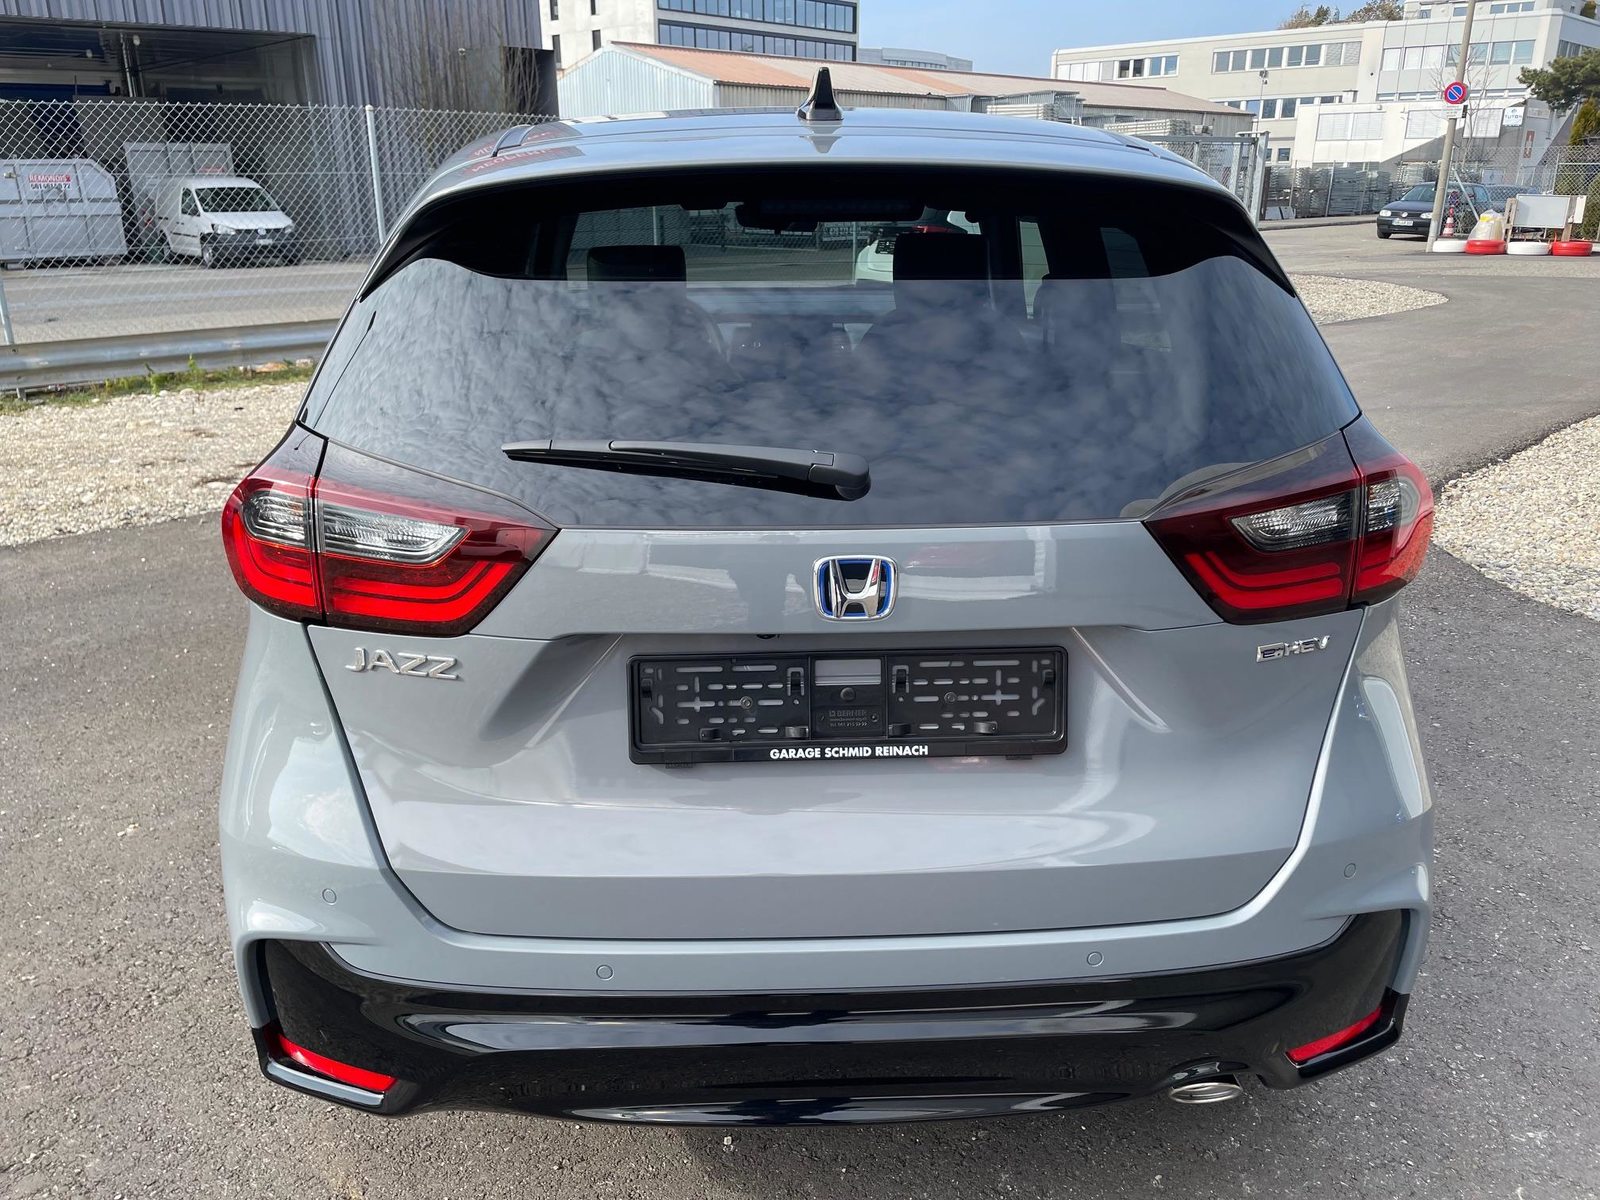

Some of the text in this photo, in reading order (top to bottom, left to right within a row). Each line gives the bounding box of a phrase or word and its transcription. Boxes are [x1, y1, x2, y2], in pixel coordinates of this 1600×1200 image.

[345, 647, 460, 680] JAZZ
[769, 745, 929, 760] GARAGE SCHMID REINACH
